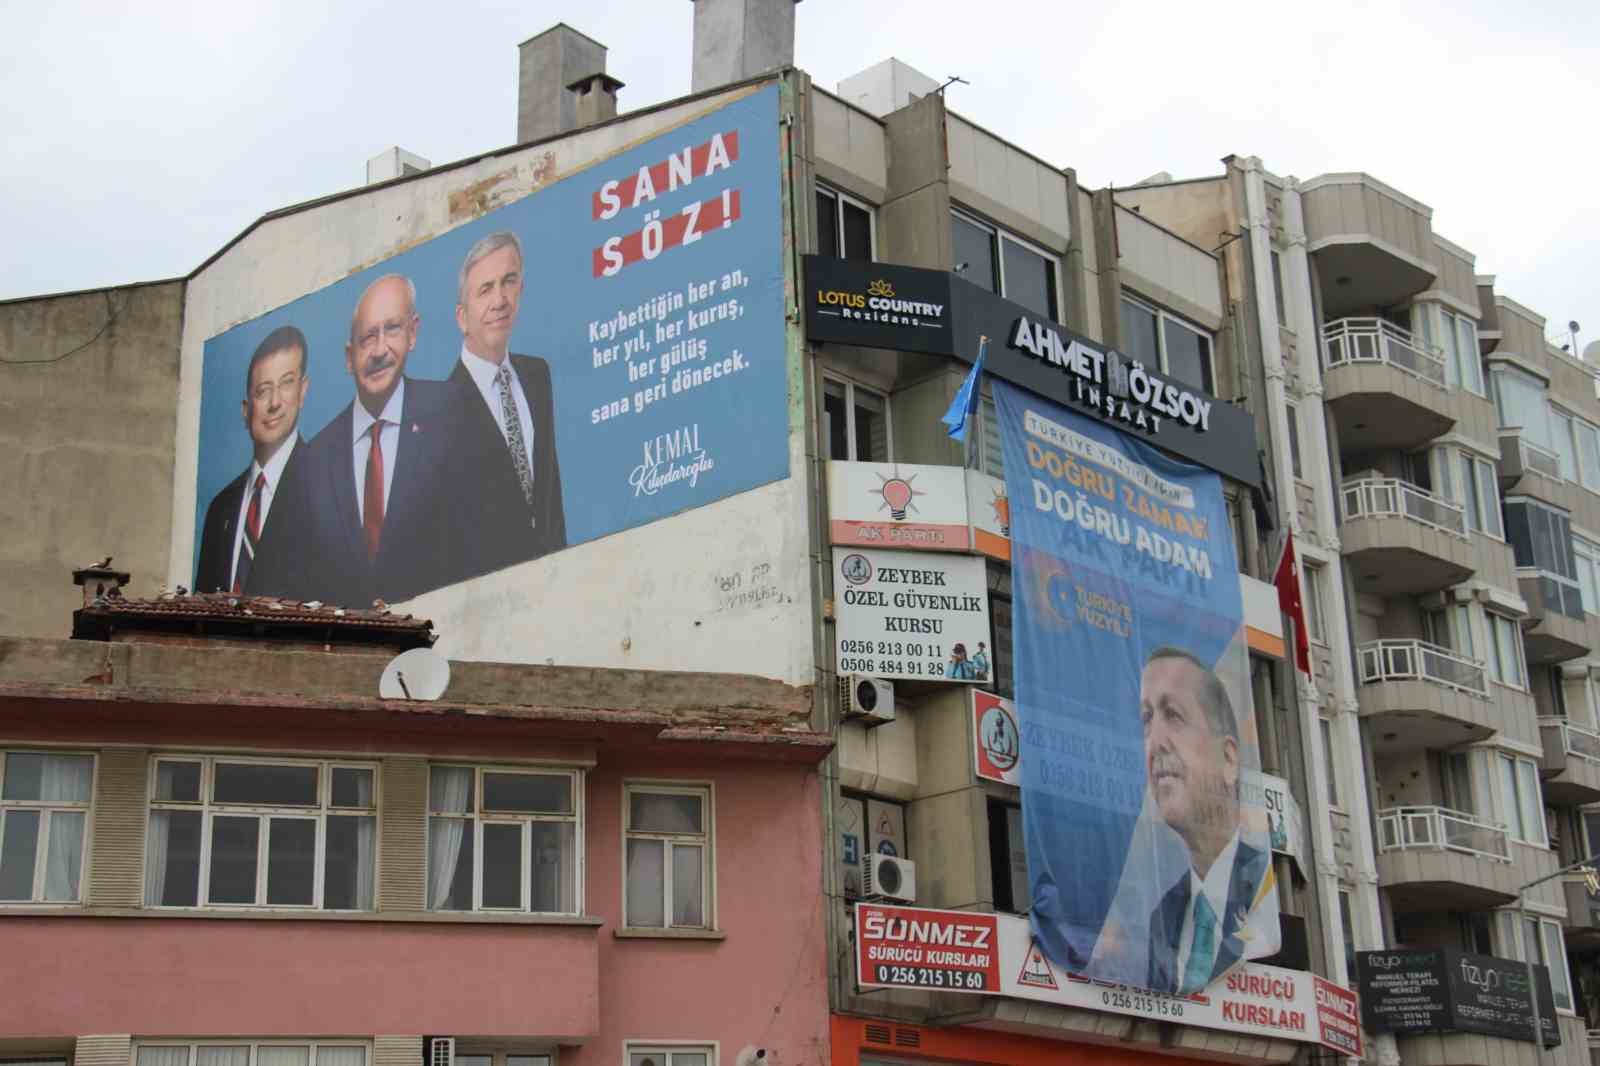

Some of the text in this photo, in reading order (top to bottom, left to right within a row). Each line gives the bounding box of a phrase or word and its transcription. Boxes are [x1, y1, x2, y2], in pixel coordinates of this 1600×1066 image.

[600, 133, 731, 219] SANA
[602, 188, 732, 276] SÖZ!
[589, 269, 749, 343] Kaybettiğin her an,
[818, 290, 944, 317] LOTUS COUNTRY
[592, 299, 744, 368] her yıl, her kuruş,
[628, 339, 707, 382] her gülüş
[1014, 316, 1211, 431] AHMET ÖZSOY
[592, 350, 750, 424] sana geri dönecek.
[1075, 376, 1161, 433] İNŞAAT
[643, 424, 702, 468] KEMAL
[1026, 441, 1116, 501] DOĞRU
[856, 526, 884, 541] AK
[1031, 478, 1212, 579] DOĞRU ADAM
[877, 567, 946, 586] ZEYBEK
[844, 585, 982, 612] ÖZEL GÜVENLİK
[884, 616, 943, 634] KURSU
[841, 640, 943, 658] 0256 213 00 11
[841, 657, 945, 676] 0506 484 91 28
[868, 943, 990, 968] SÜRÜCÜ KURSLARI
[879, 968, 982, 988] 0 256 215 15 60
[1226, 969, 1295, 1000] SÜRÜCÜ
[1102, 991, 1184, 1017] 0 256 215 15 60
[1221, 999, 1305, 1030] KURSLARI
